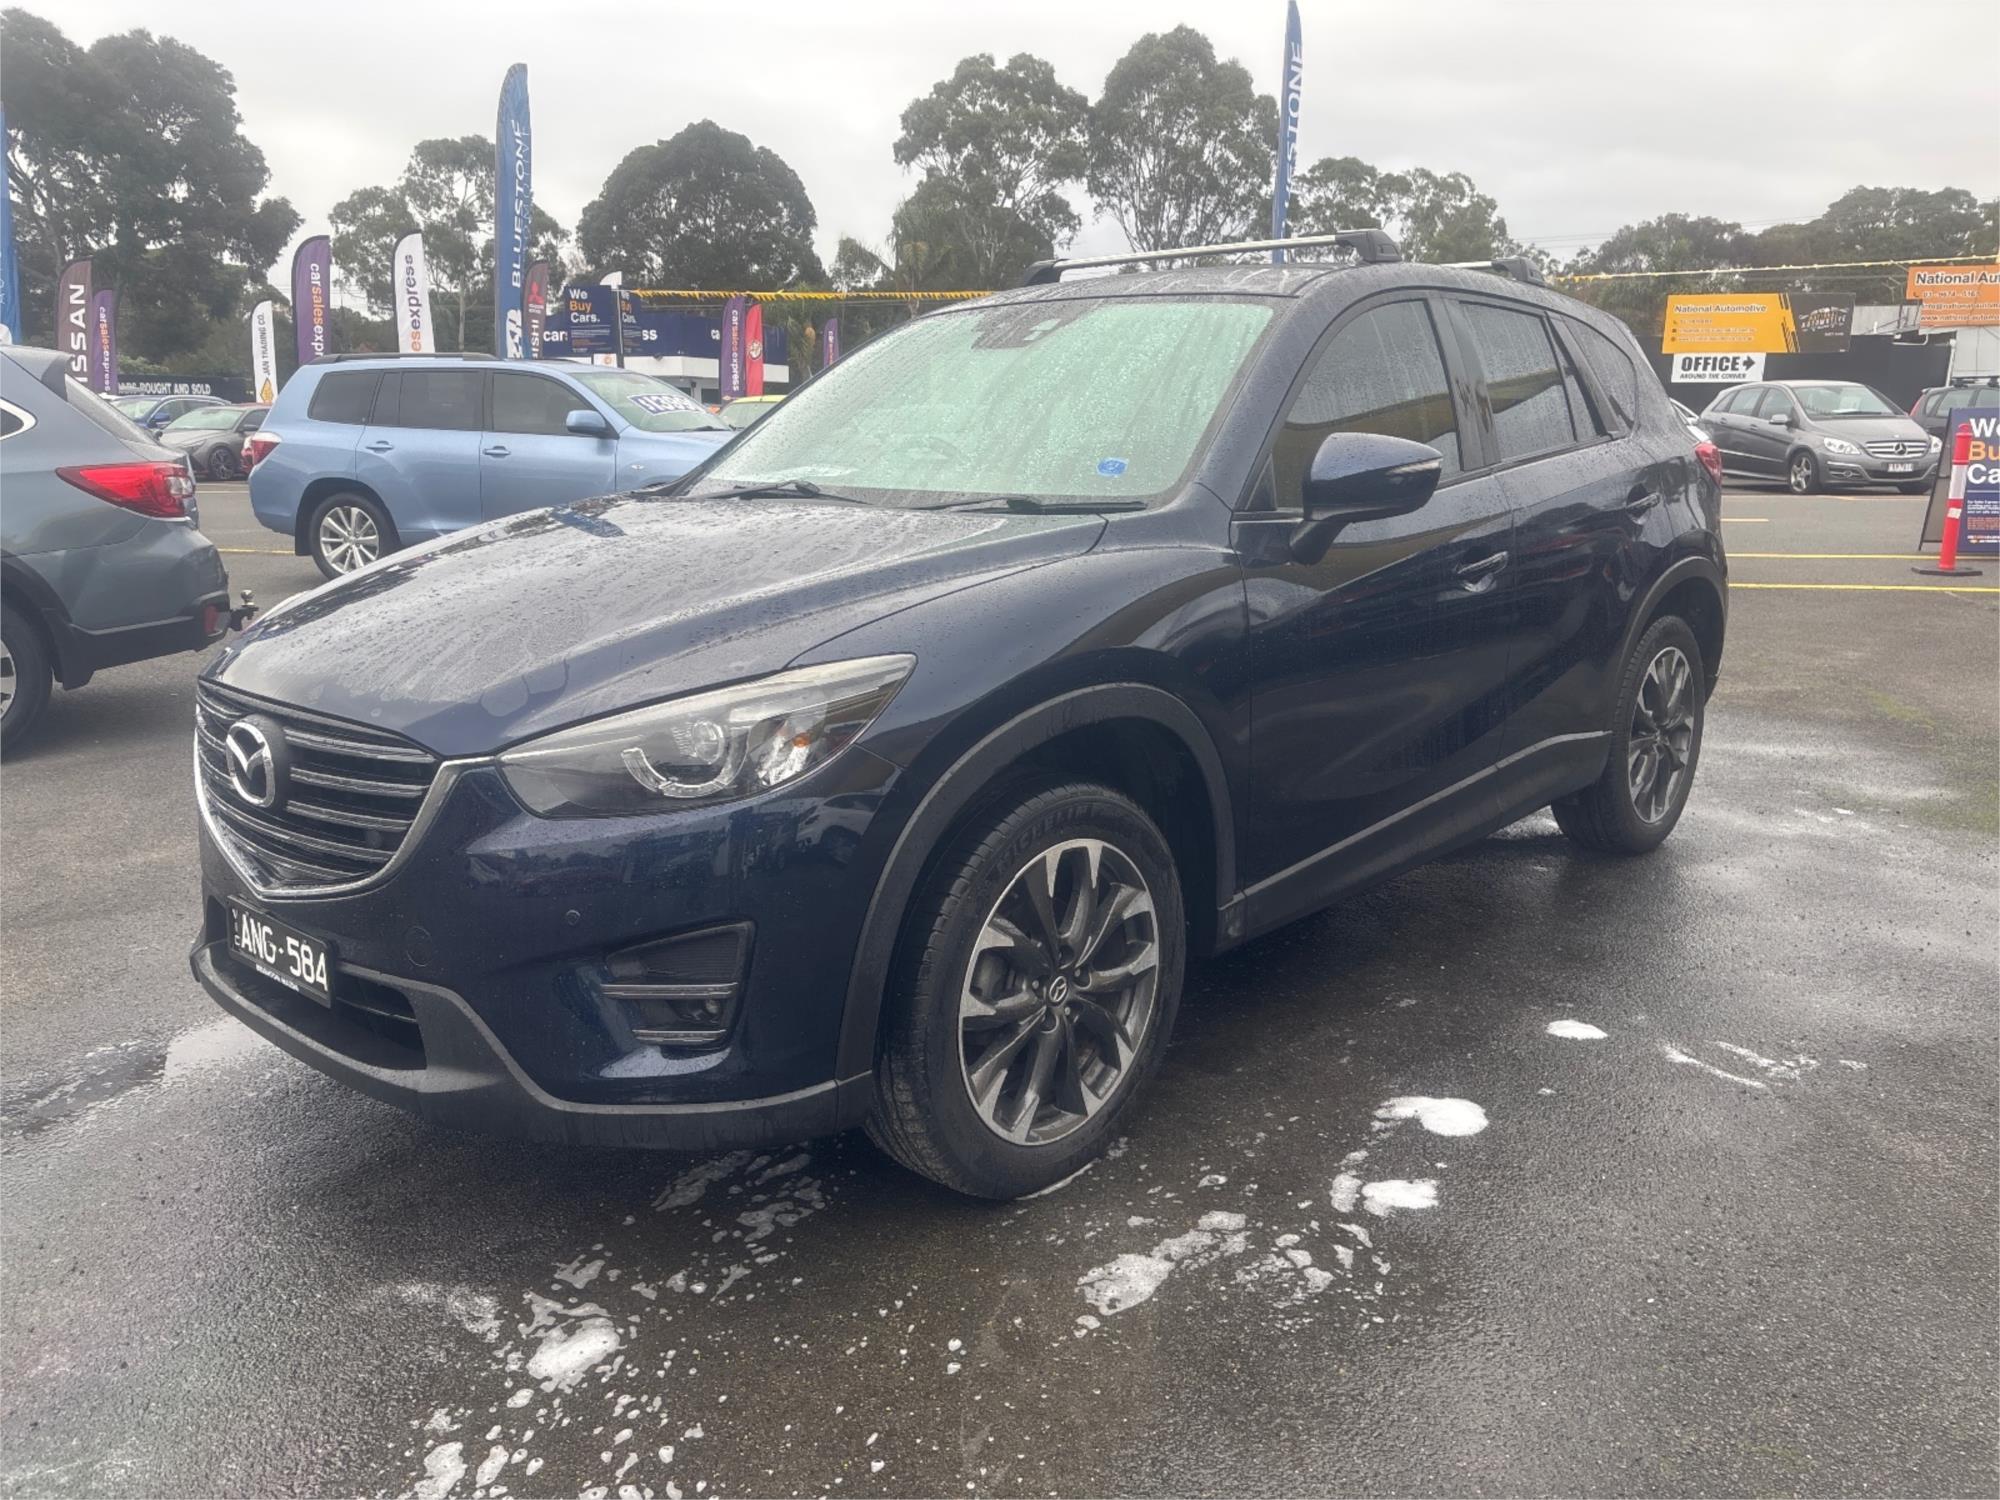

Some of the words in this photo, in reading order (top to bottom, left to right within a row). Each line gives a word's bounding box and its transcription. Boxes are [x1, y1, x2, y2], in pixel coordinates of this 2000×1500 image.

[511, 119, 524, 288] BLUESTONE
[1915, 272, 1974, 284] National
[569, 289, 588, 300] We
[310, 263, 325, 357] carsalesexpr
[404, 254, 422, 352] esexpress
[569, 300, 592, 313] Buy
[1674, 305, 1712, 313] National
[1714, 304, 1767, 312] Automotive
[570, 312, 601, 323] Cars.
[69, 284, 88, 383] ISSAN
[1681, 356, 1741, 372] OFFICE
[174, 383, 189, 394] AND
[191, 383, 211, 394] SOLD
[1969, 440, 2000, 461] Bu
[1967, 463, 2000, 484] Ca
